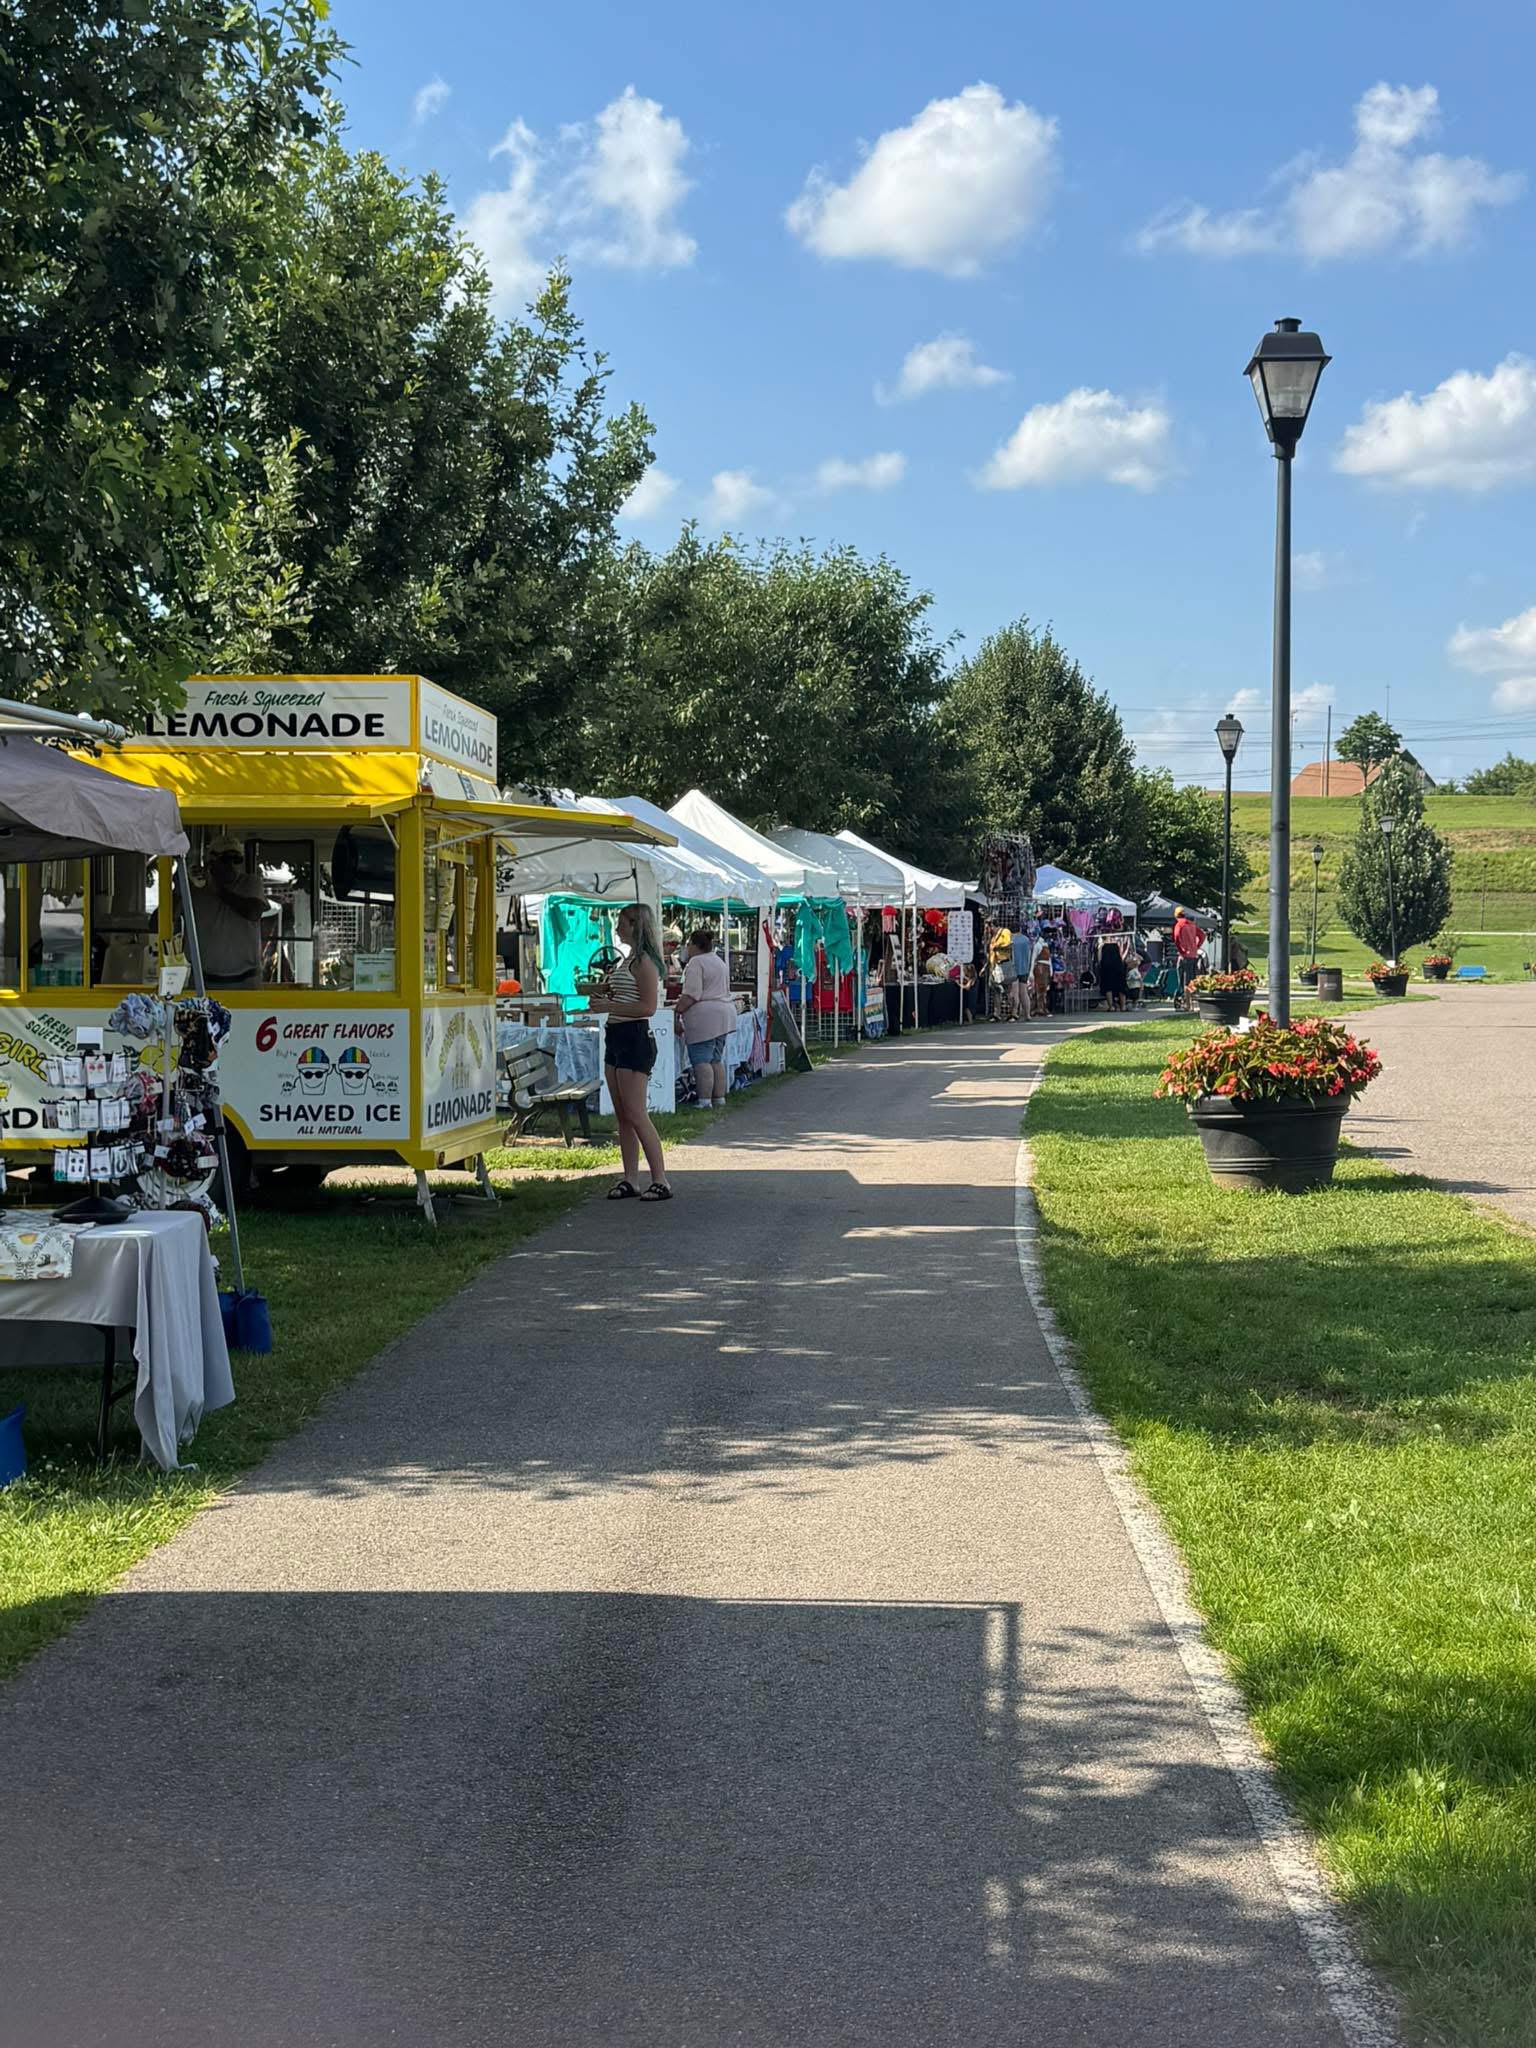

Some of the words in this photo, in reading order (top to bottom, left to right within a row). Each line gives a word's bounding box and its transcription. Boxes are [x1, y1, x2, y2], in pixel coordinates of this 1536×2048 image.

[205, 690, 248, 705] Fresh
[252, 691, 325, 715] Squeezed
[146, 713, 385, 737] LEMONADE
[425, 715, 493, 767] LEMONADE
[25, 1021, 76, 1053] SQUEEZED
[38, 1013, 74, 1037] FRESH
[255, 1016, 278, 1052] 6
[283, 1023, 330, 1039] GREAT
[333, 1023, 395, 1039] FLAVORS
[259, 1104, 355, 1122] SHAVED
[366, 1104, 401, 1122] ICE
[427, 1090, 492, 1129] LEMONADE
[297, 1125, 315, 1135] ALL
[318, 1125, 363, 1135] NATURAL
